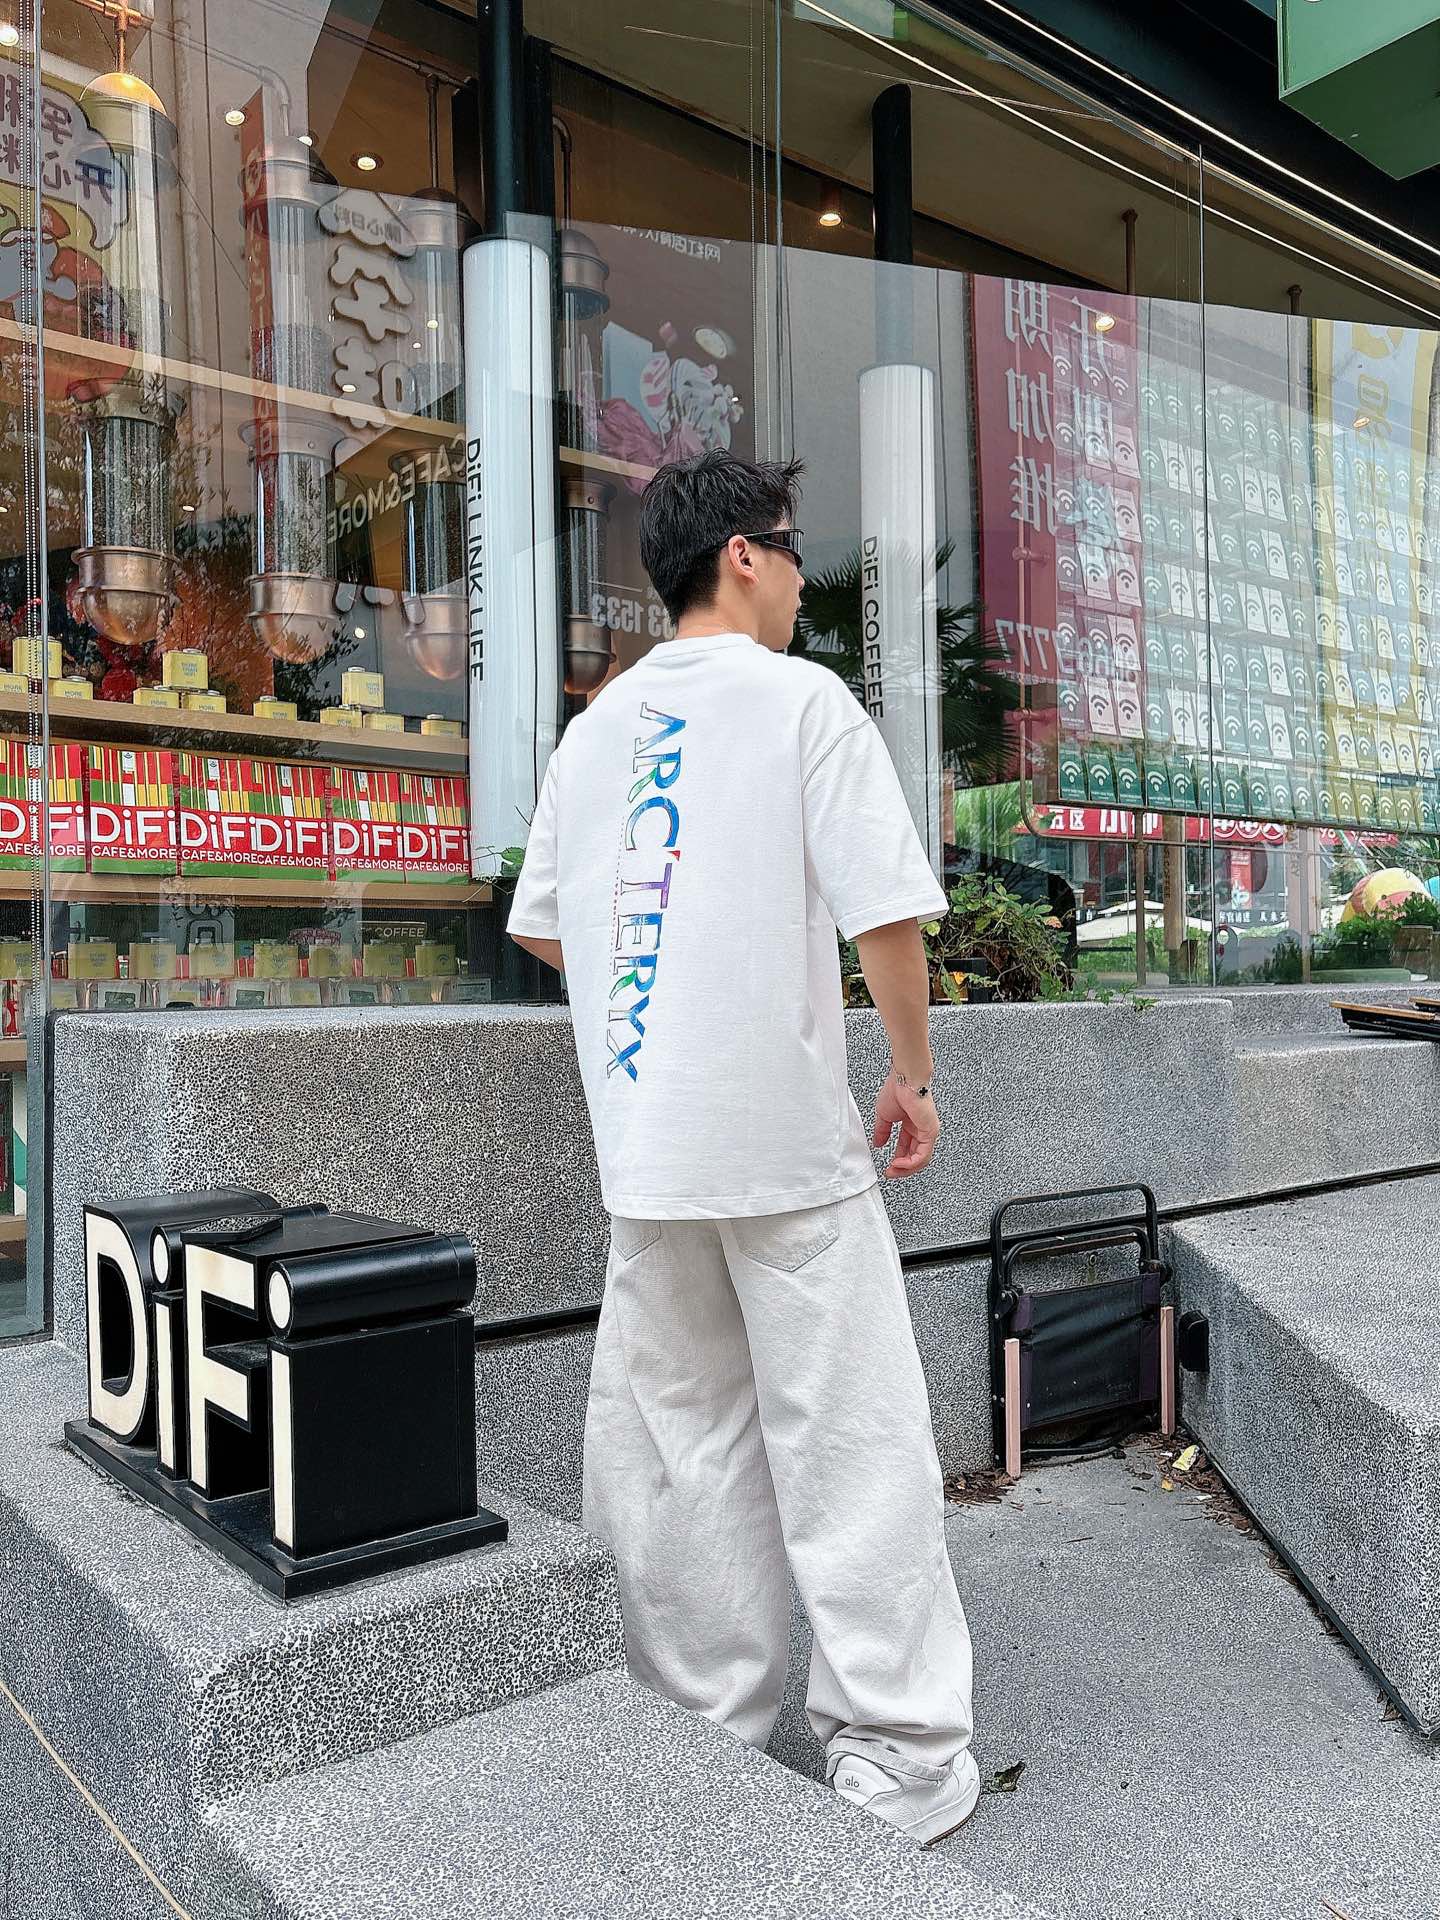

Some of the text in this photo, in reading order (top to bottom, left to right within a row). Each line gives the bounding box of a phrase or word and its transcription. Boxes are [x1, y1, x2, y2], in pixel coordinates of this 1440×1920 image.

[467, 438, 484, 685] DiFi LINK LIFE
[863, 536, 884, 719] DiFi COFFEE
[90, 806, 177, 846] DiFi
[180, 810, 257, 852] DiFi
[256, 816, 328, 856] DiFi
[332, 821, 403, 859] DiFi
[403, 825, 469, 862] DiFi
[92, 845, 177, 860] CAFE&MORE
[182, 848, 257, 864] CAFE&MORE
[257, 854, 328, 868] CAFE&MORE
[335, 857, 404, 871] CAFE&MORE
[405, 860, 470, 874] CAFE&MORE
[373, 926, 426, 938] COFFEE
[84, 1212, 295, 1550] DiFi
[844, 1775, 861, 1789] alo
